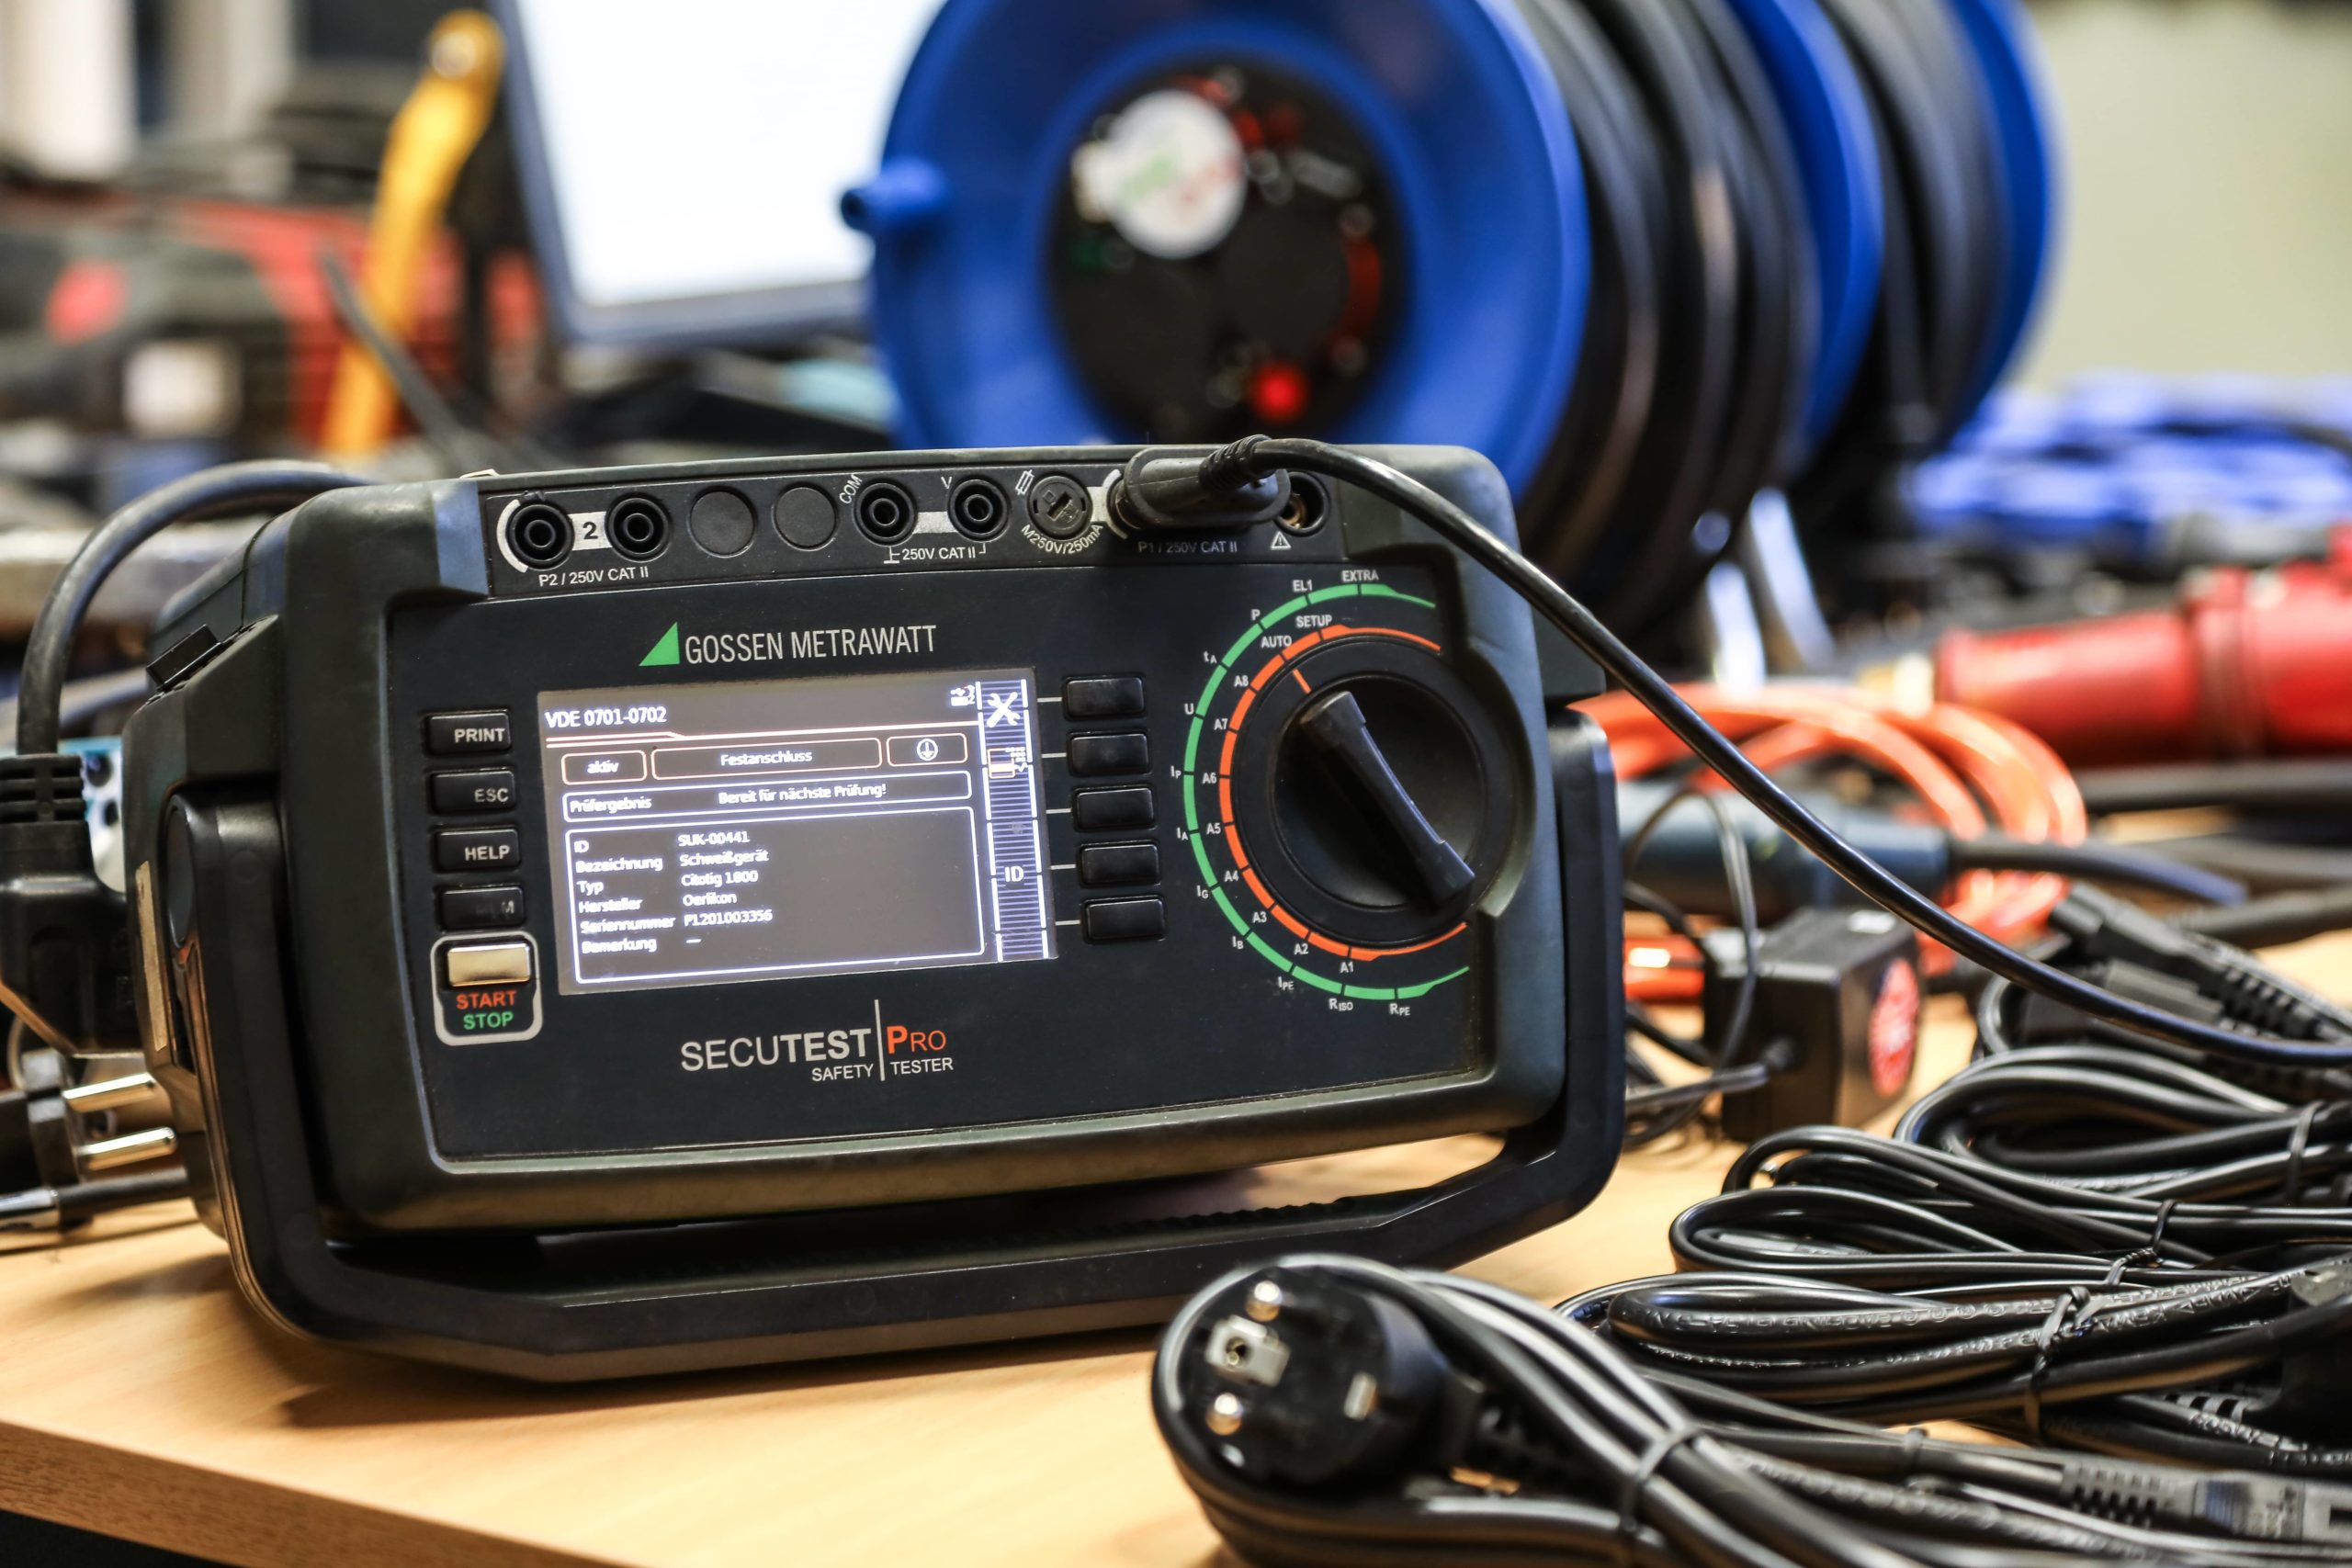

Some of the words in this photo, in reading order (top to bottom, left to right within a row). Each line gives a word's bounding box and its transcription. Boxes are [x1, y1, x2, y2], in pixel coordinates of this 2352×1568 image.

[839, 473, 863, 504] COM
[941, 476, 953, 489] V
[582, 522, 598, 540] 2
[1021, 525, 1103, 555] M250V/250mA
[1200, 542, 1227, 552] CAT
[901, 547, 935, 560] 250V
[938, 547, 965, 559] CAT
[968, 547, 976, 558] II
[538, 573, 558, 587] P2
[569, 569, 605, 584] 250V
[608, 567, 635, 582] CAT
[639, 566, 650, 579] II
[1341, 570, 1379, 582] EXTRA
[1293, 580, 1313, 592] EL1
[1251, 609, 1261, 621] P
[1295, 615, 1332, 628] SETUP
[684, 633, 783, 665] GOSSEN
[791, 625, 936, 660] METRAWATT
[1261, 635, 1293, 649] AUTO
[1234, 675, 1249, 687] A8
[544, 711, 581, 728] VDE
[584, 706, 667, 726] 0701-0702
[1184, 703, 1194, 716] U
[1214, 718, 1228, 731] A7
[454, 728, 505, 743] PRINT
[720, 750, 813, 766] Festanschluss
[587, 760, 619, 774] aktiv
[1203, 773, 1217, 784] A6
[474, 788, 509, 803] ESC
[718, 790, 757, 805] Bereit
[758, 789, 777, 802] für
[779, 785, 831, 800] nächste
[834, 784, 887, 800] Prüfung!
[570, 796, 652, 814] Prüfergebnis
[1206, 823, 1221, 835] A5
[573, 840, 590, 853] ID
[678, 830, 751, 847] SUK-00441
[464, 845, 511, 862] HELP
[575, 856, 663, 873] Bezeichnung
[680, 849, 770, 867] Schweißgerät
[1004, 866, 1024, 882] ID
[1224, 871, 1239, 883] A4
[576, 880, 605, 896] Typ
[578, 897, 643, 913] Hersteller
[682, 892, 738, 907] Oerlikon
[580, 917, 676, 933] Seriennummer
[1252, 912, 1267, 924] A3
[582, 937, 657, 954] Bemerkung
[1294, 943, 1309, 955] A2
[1340, 962, 1354, 974] A1
[456, 990, 517, 1010] START
[463, 1011, 514, 1031] STOP
[681, 1028, 872, 1072] SECUTEST
[811, 1062, 875, 1082] SAFETY
[890, 1057, 955, 1076] TESTER
